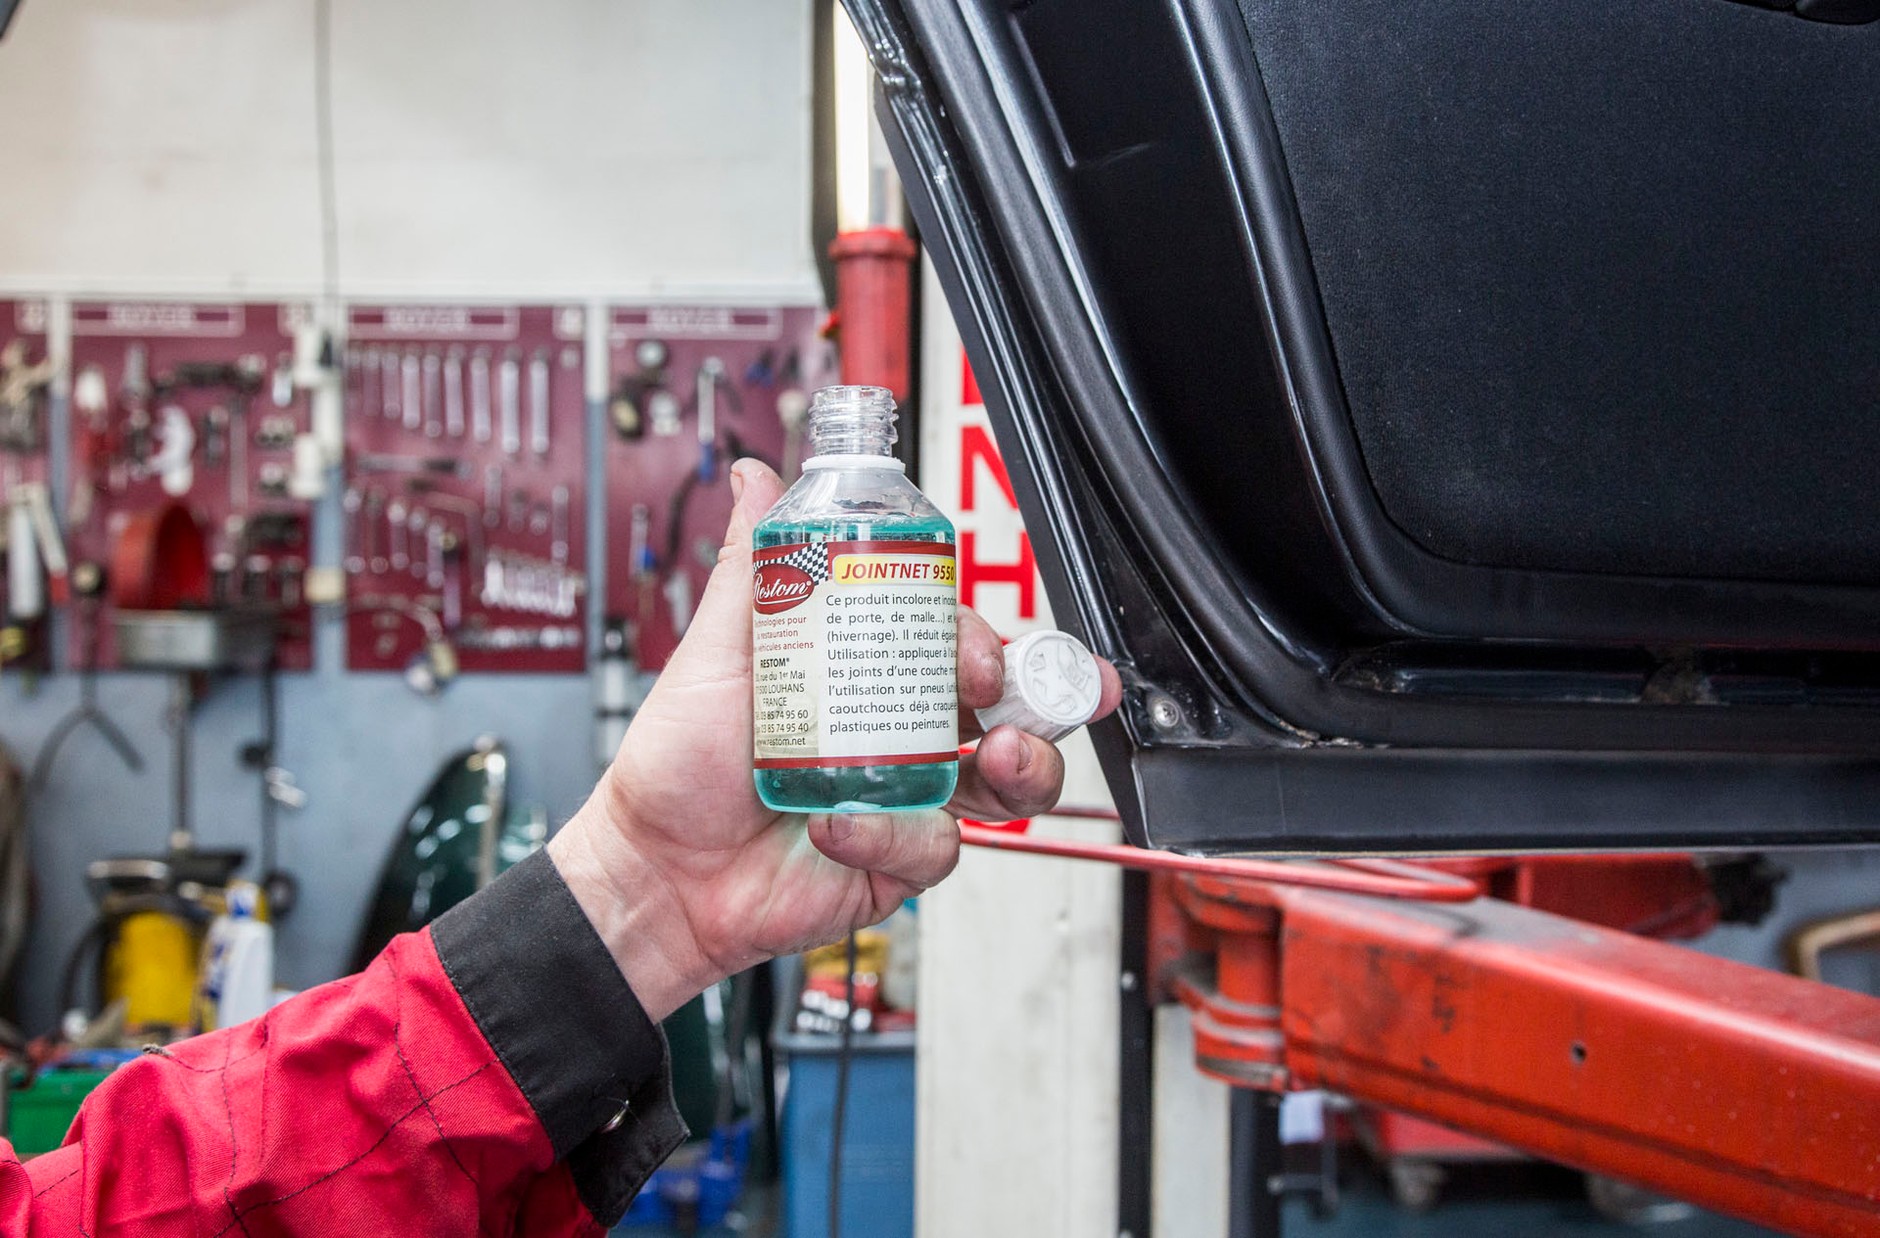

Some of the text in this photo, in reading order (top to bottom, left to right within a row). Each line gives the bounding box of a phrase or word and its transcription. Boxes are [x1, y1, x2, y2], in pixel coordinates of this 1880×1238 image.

[841, 563, 955, 581] JOINTNET 9550
[826, 594, 842, 606] Ce
[844, 593, 890, 608] produit
[892, 593, 932, 605] incolore
[933, 595, 942, 605] et
[787, 616, 807, 626] pour
[826, 613, 842, 624] de
[848, 613, 885, 626] porte,
[890, 611, 905, 623] de
[827, 629, 899, 644] (hivernage).
[913, 629, 940, 641] réduit
[783, 640, 814, 650] anciens
[827, 648, 889, 660] Utilisation
[898, 647, 943, 661] appliquer
[790, 670, 806, 680] Mai
[828, 667, 845, 678] les
[848, 666, 882, 681] joints
[886, 665, 918, 677] d'une
[920, 664, 948, 676] couche
[768, 682, 805, 694] LOUHANS
[828, 684, 895, 696] l'utilisation
[899, 685, 916, 695] sur
[920, 685, 945, 697] pneus
[762, 696, 788, 707] FRANCE
[829, 701, 905, 715] caoutchoucs
[909, 700, 930, 714] déjà
[767, 710, 775, 720] 85
[775, 710, 785, 719] 74
[785, 709, 796, 719] 95
[797, 709, 809, 719] 60
[767, 723, 775, 733] 85
[775, 723, 785, 733] 74
[785, 723, 796, 733] 95
[797, 722, 809, 732] 40
[830, 720, 892, 736] plastiques
[894, 721, 909, 731] ou
